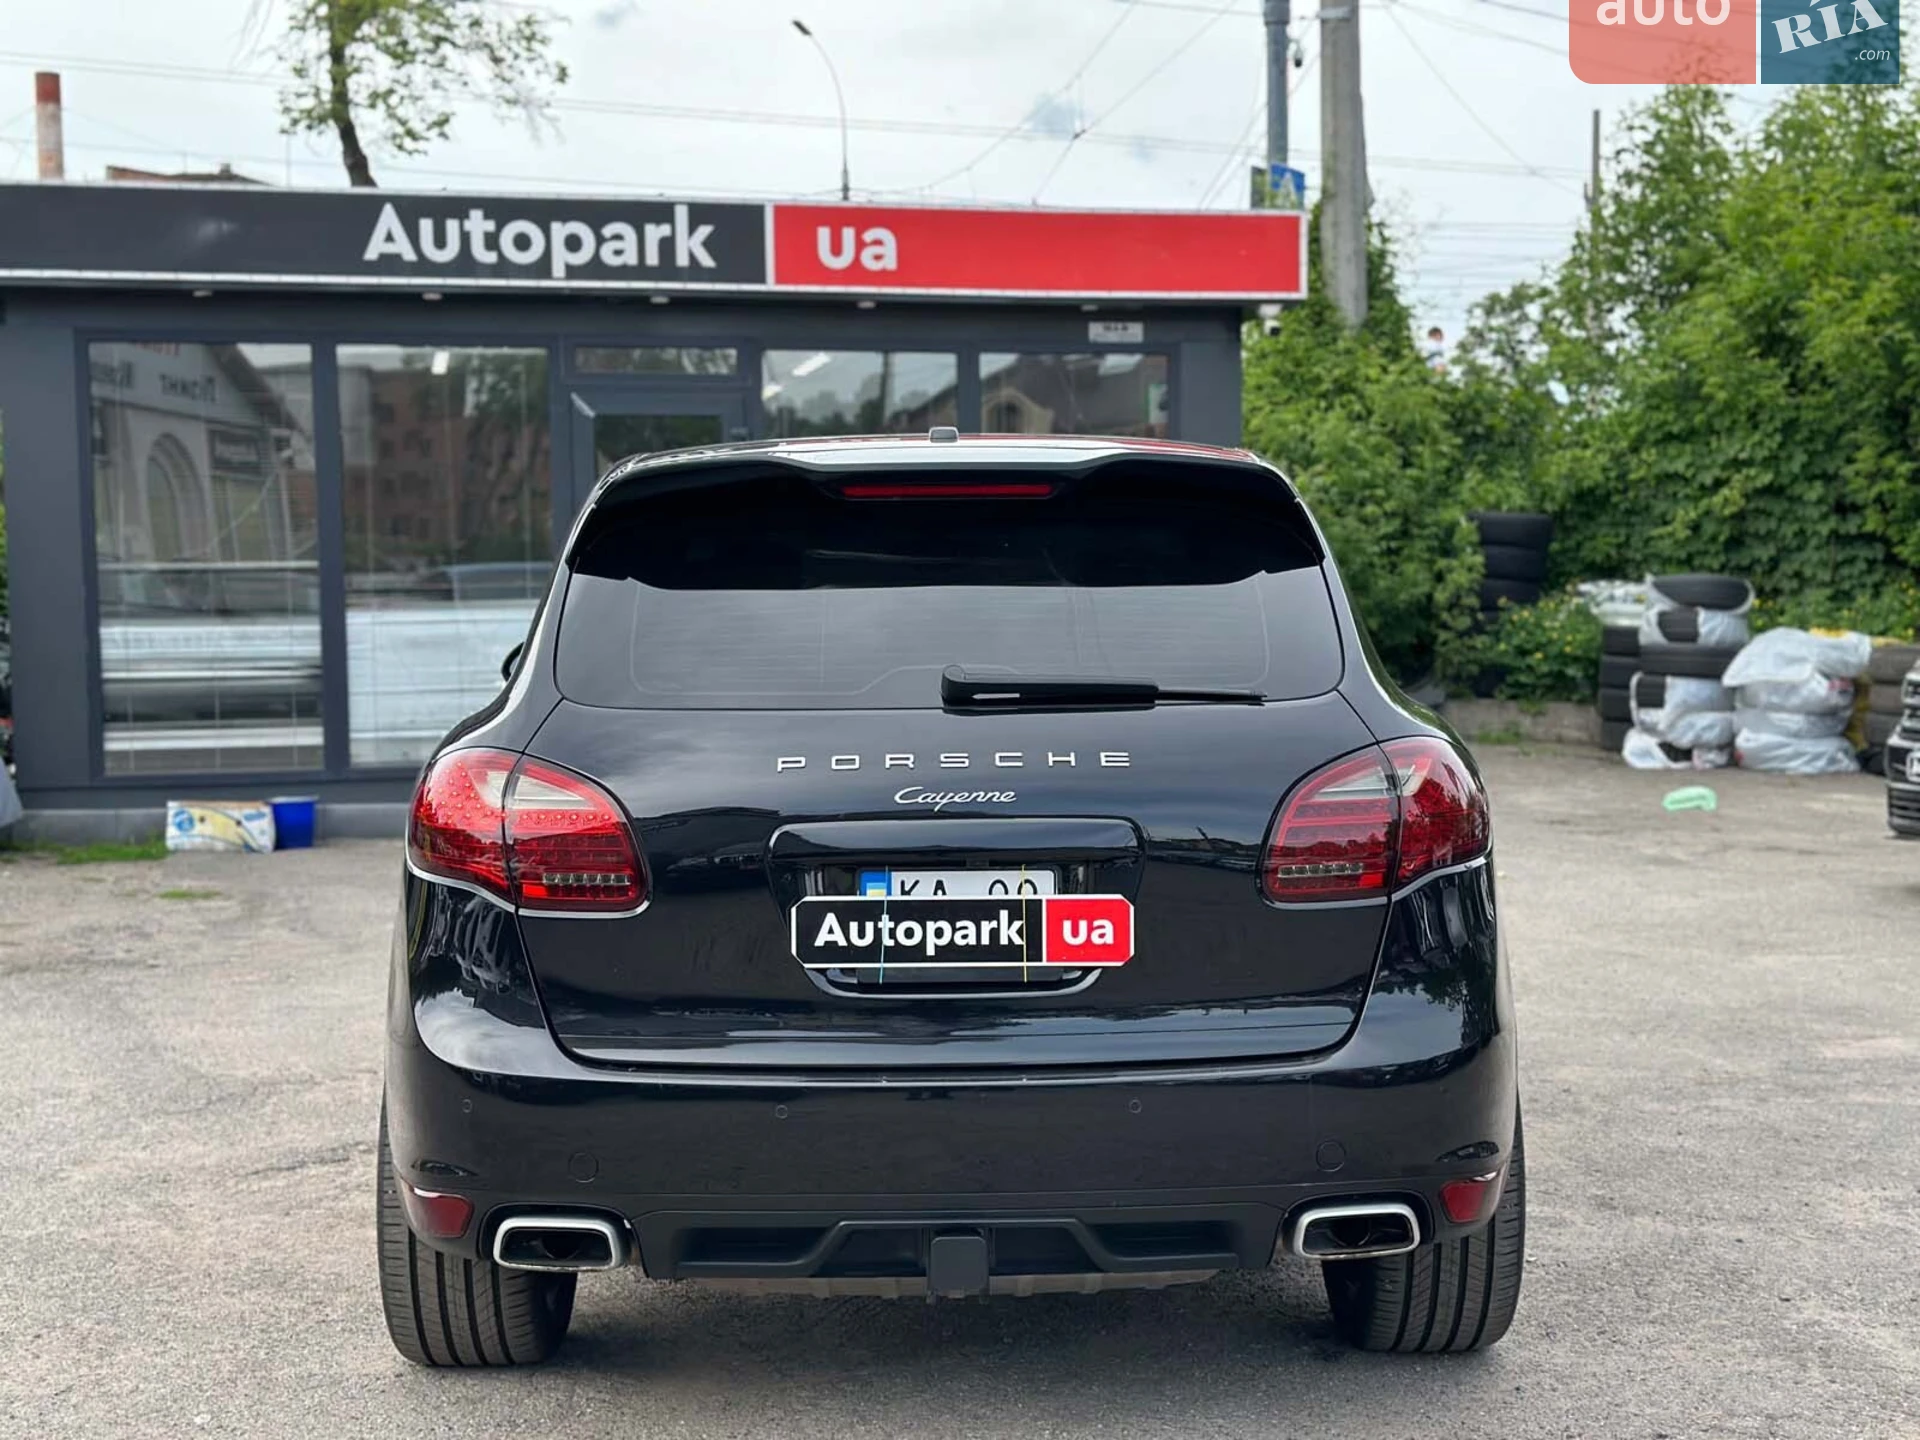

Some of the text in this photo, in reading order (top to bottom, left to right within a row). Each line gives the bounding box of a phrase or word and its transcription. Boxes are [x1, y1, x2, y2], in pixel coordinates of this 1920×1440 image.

[363, 202, 898, 278] Autopark ua
[777, 751, 1131, 773] PORSCHE
[894, 786, 1017, 812] Cayenne
[814, 909, 1114, 956] Autopark ua
